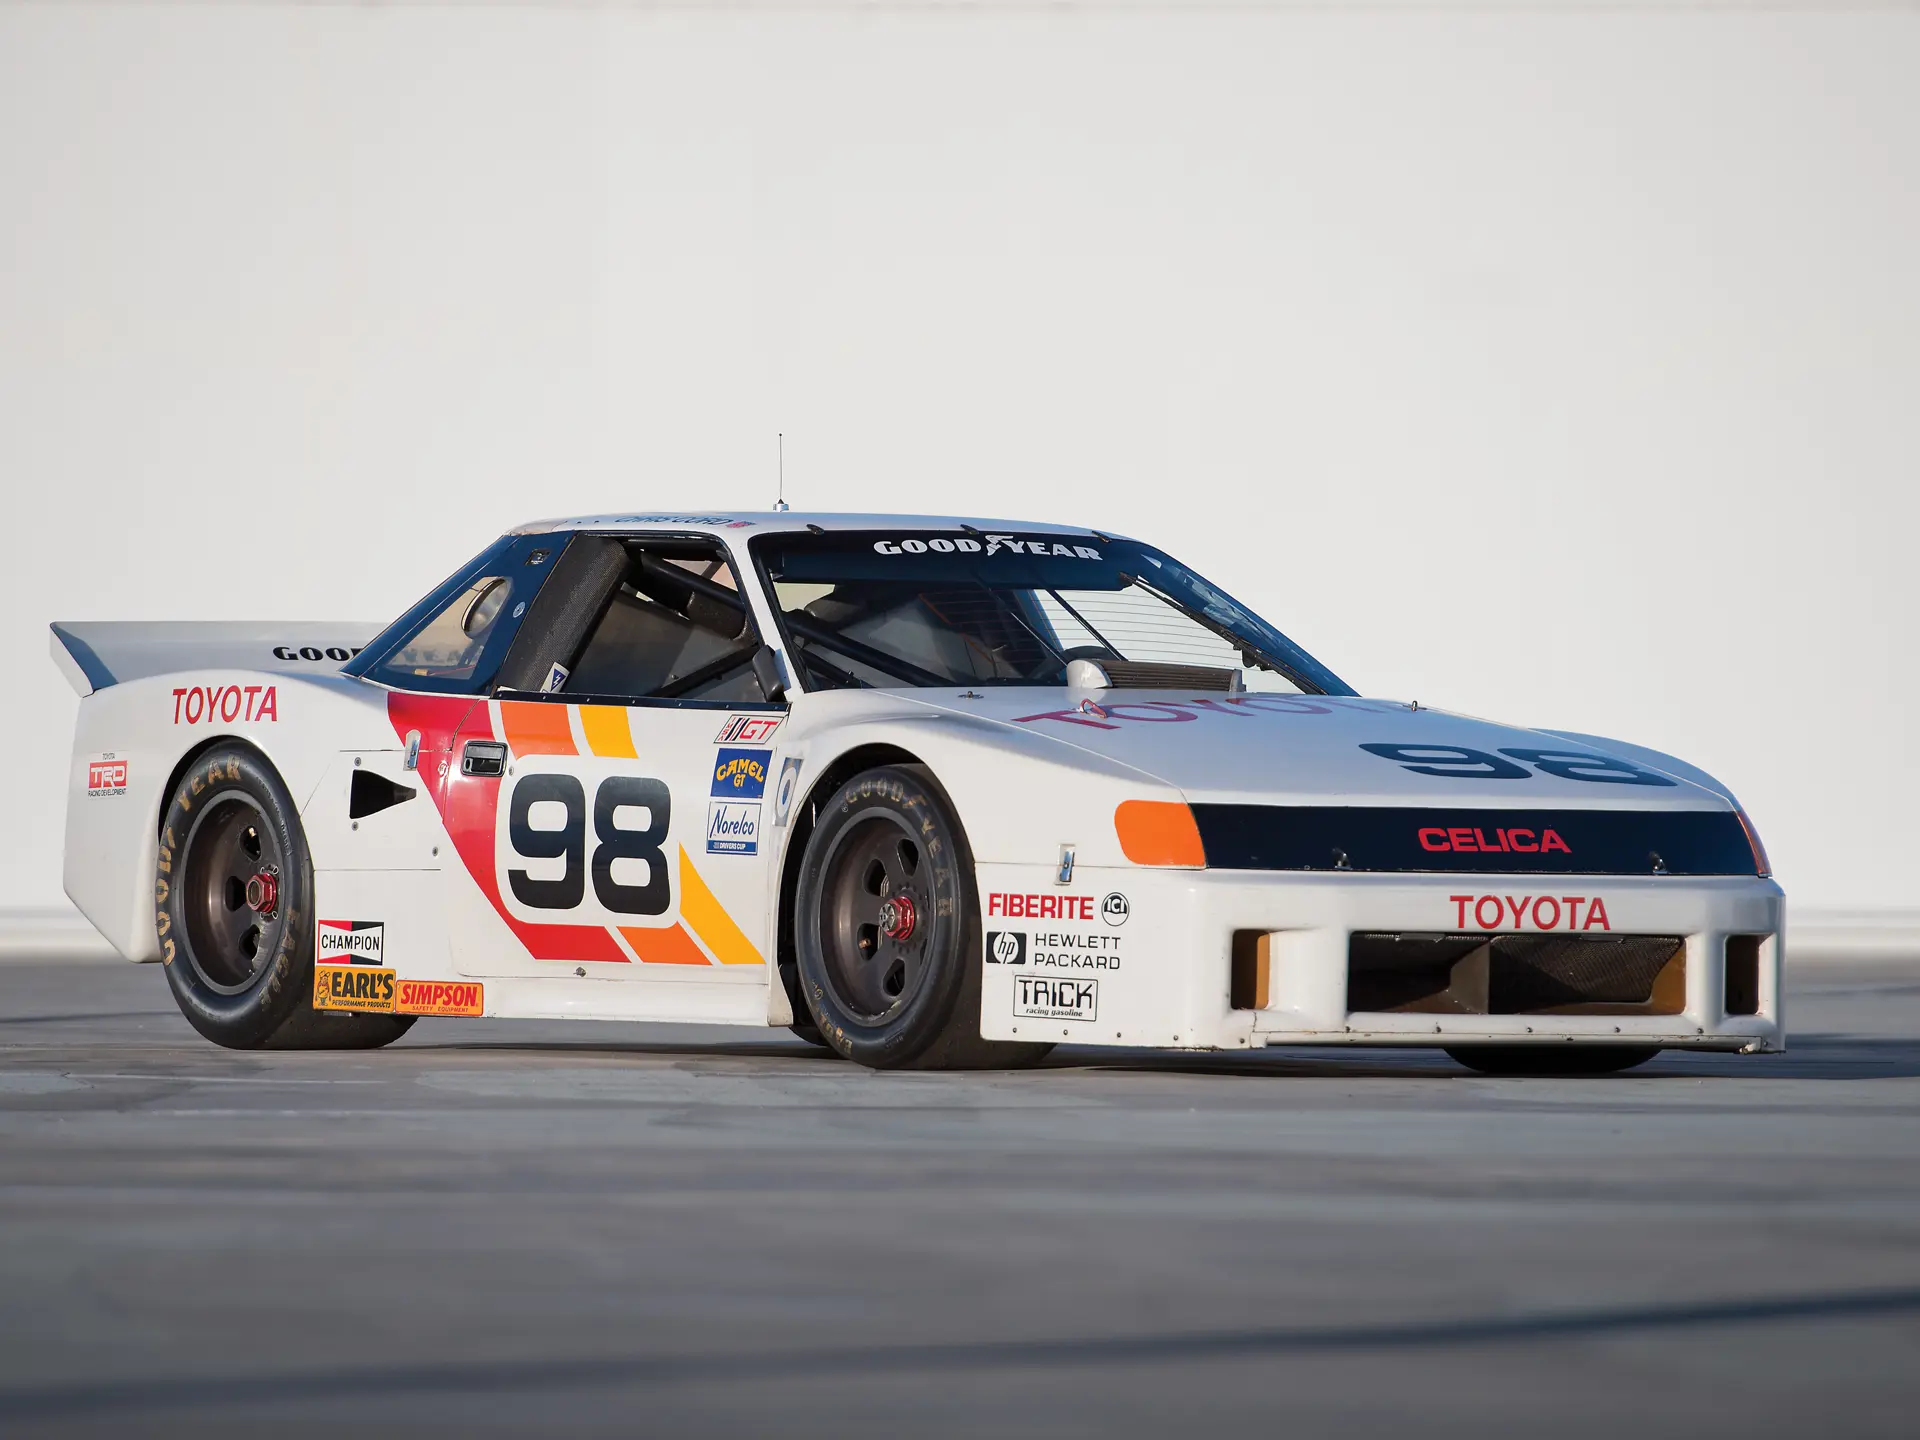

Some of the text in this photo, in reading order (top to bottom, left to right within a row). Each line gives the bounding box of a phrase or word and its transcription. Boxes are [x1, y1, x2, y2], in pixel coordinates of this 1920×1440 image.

[873, 538, 1103, 561] GOOD YEAR
[172, 685, 278, 725] TOYOTA
[739, 720, 779, 740] GT
[90, 766, 125, 787] TRD
[716, 758, 765, 783] CAMEL
[1358, 743, 1678, 787] 98
[733, 773, 746, 787] GT
[709, 804, 755, 839] Norelco
[487, 773, 672, 916] 98
[1417, 827, 1573, 853] CELICA
[988, 893, 1095, 920] FIBERITE
[1106, 898, 1126, 914] ICI
[1450, 895, 1611, 931] TOYOTA
[321, 934, 380, 951] CHAMPION
[997, 931, 1016, 965] hp
[1035, 933, 1121, 950] HEWLETT
[1034, 953, 1121, 970] PACKARD
[331, 971, 394, 1001] EARL'S
[400, 983, 478, 1007] SIMPSON
[1018, 979, 1093, 1009] TRICK
[331, 1000, 392, 1009] PERFORMANCE PRODUCTS
[1025, 1007, 1083, 1017] racing gasoline
